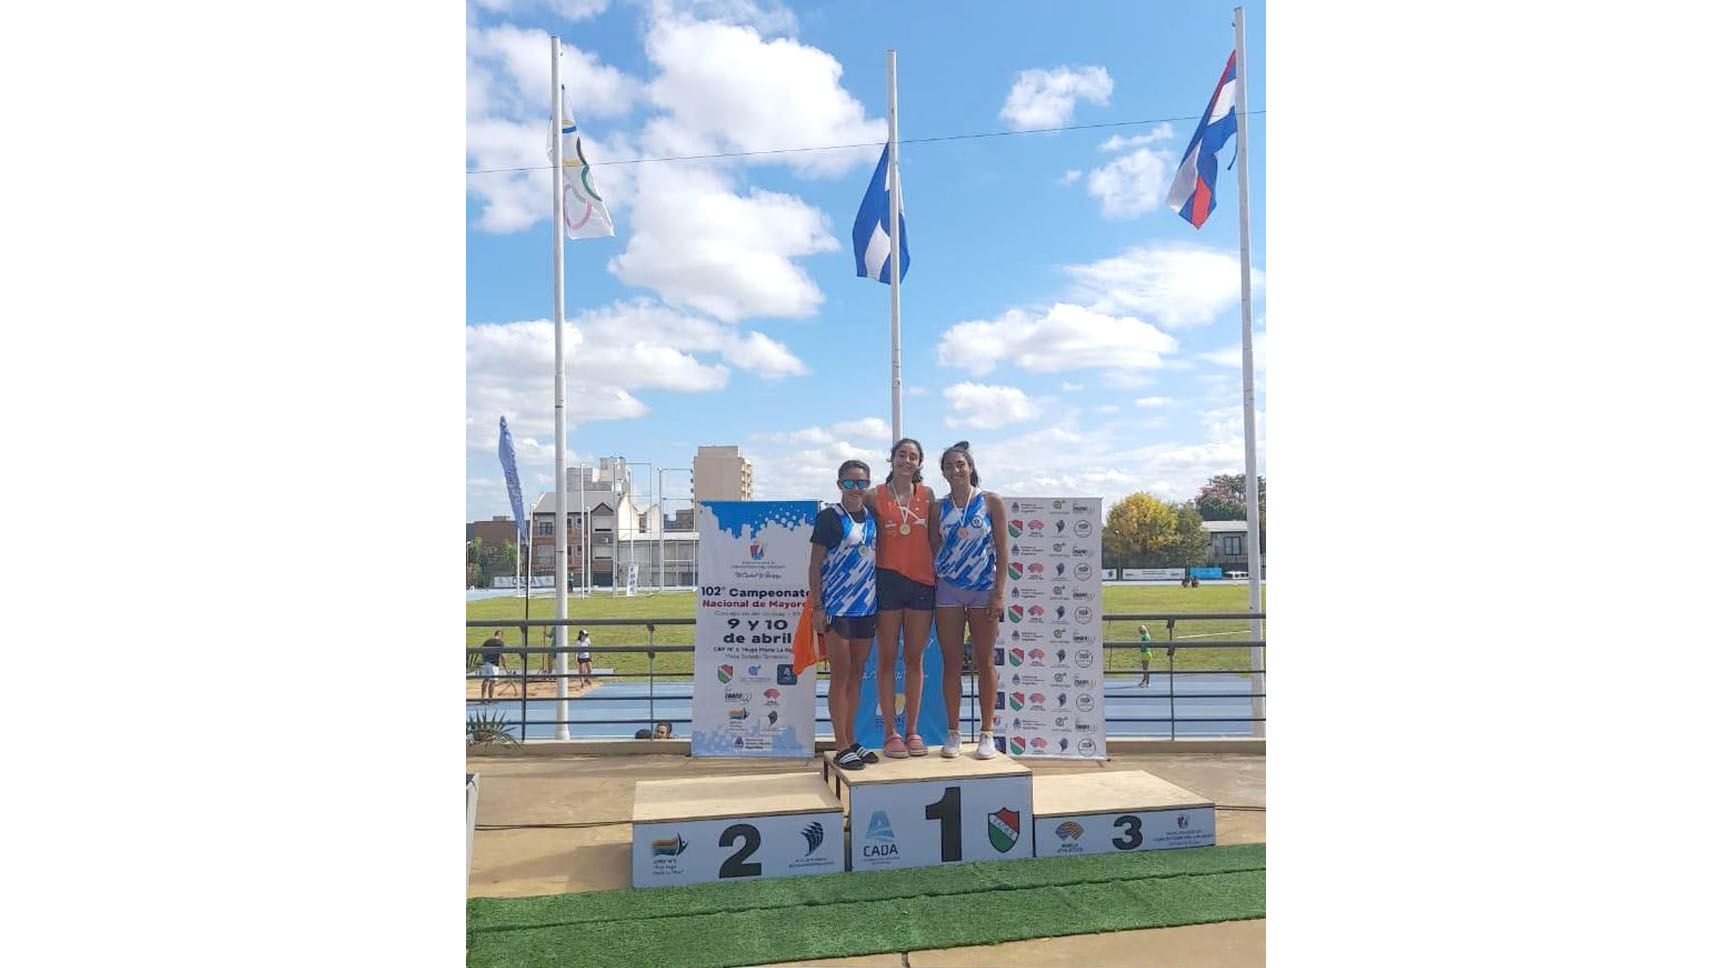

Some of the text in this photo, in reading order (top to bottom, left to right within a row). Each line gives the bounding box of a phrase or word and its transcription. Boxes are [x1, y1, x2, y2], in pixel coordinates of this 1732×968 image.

[702, 600, 749, 608] Nacional
[752, 600, 766, 608] de
[727, 618, 788, 631] 9 y 10
[723, 633, 792, 644] de abril
[925, 786, 962, 862] 1
[1112, 815, 1143, 850] 3
[718, 823, 762, 879] 2
[863, 844, 899, 857] CADA
